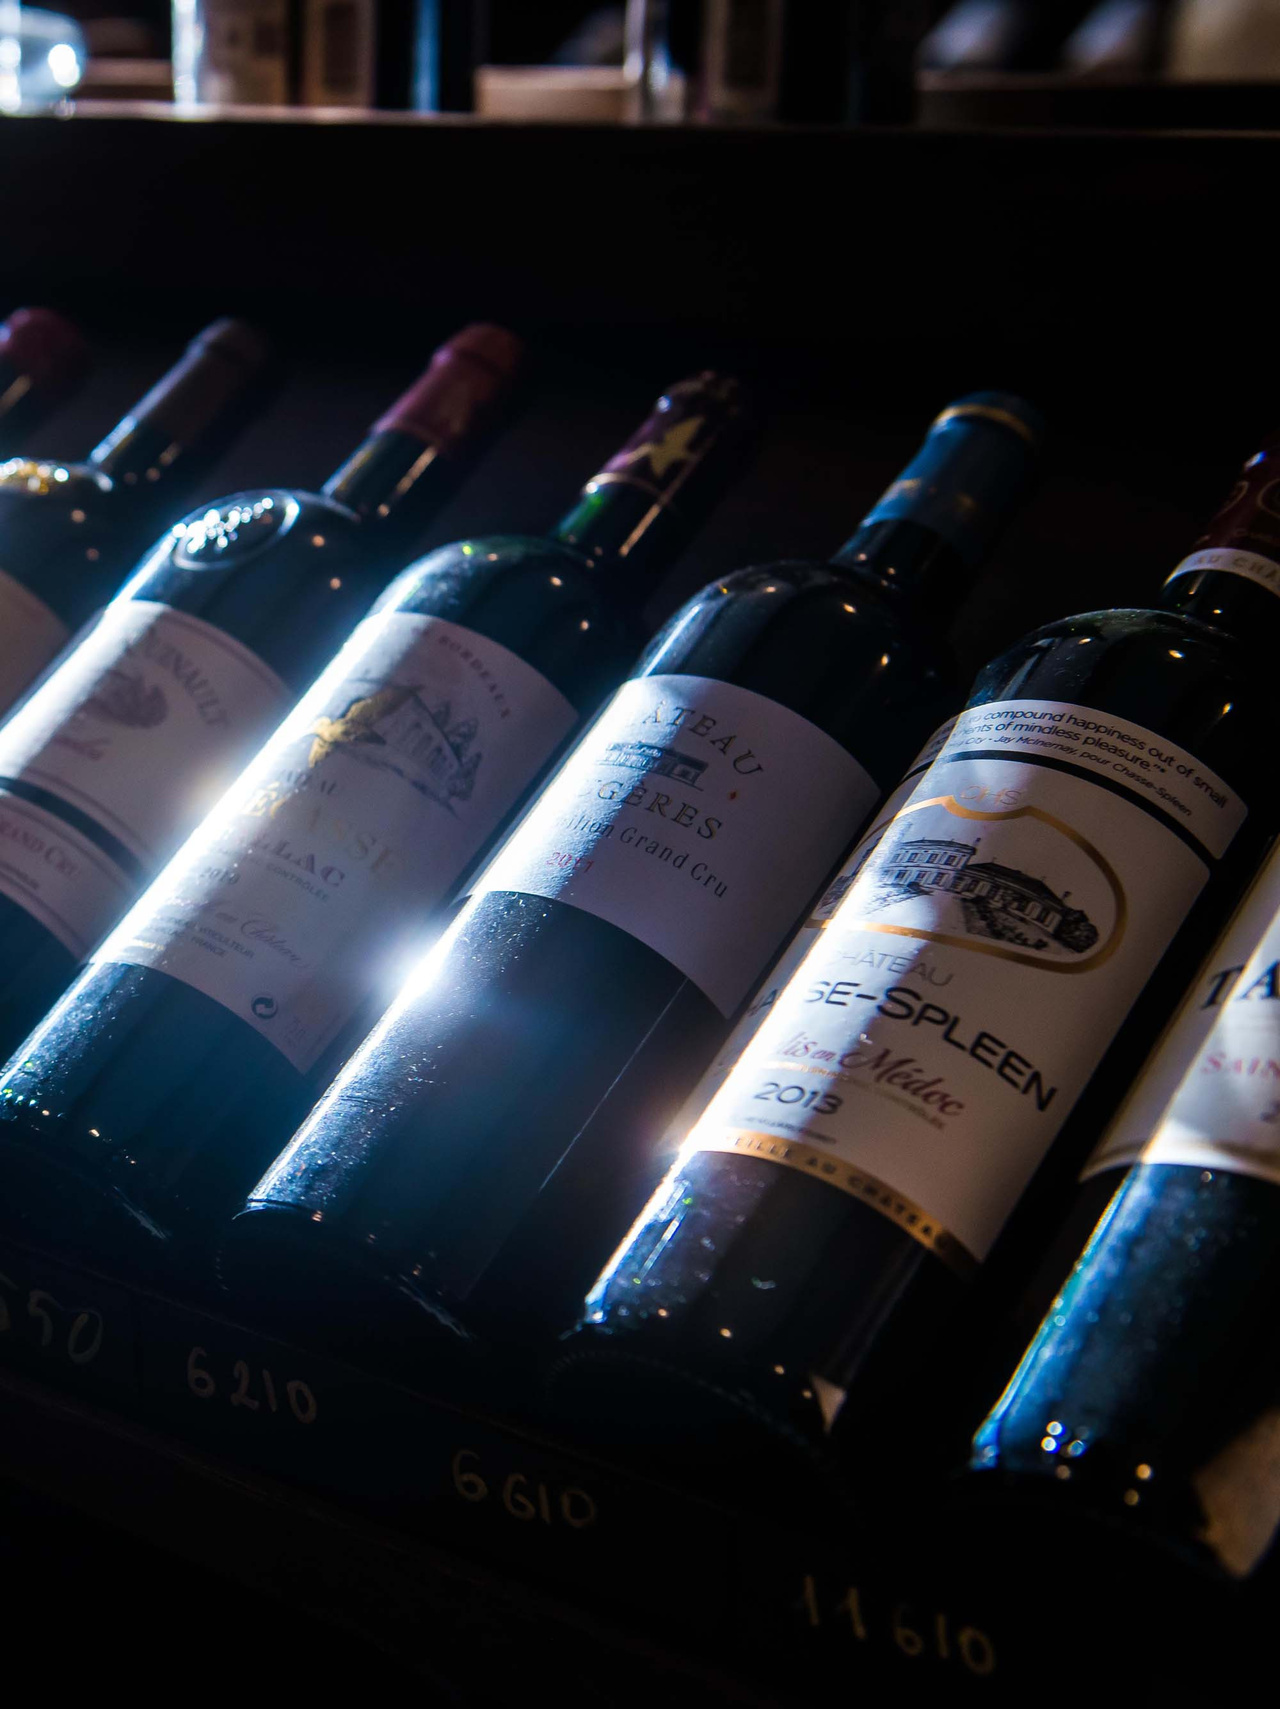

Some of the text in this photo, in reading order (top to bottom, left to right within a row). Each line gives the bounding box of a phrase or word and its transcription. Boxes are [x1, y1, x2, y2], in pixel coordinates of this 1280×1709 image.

[983, 710, 1066, 723] compound
[1066, 713, 1145, 751] happiness
[1148, 746, 1176, 767] out
[1176, 763, 1195, 778] of
[1193, 775, 1229, 809] small
[995, 721, 1013, 732] of
[1013, 722, 1081, 741] mindless
[584, 778, 723, 839] GÈRES
[994, 735, 1014, 744] Jay
[1079, 750, 1111, 767] pour
[1112, 763, 1193, 817] Chasse-Spleen
[620, 826, 690, 870] Grand
[690, 862, 728, 898] Cru
[826, 949, 954, 986] HÂTEAU
[754, 1082, 843, 1115] 2013
[839, 1046, 965, 1117] Médoc
